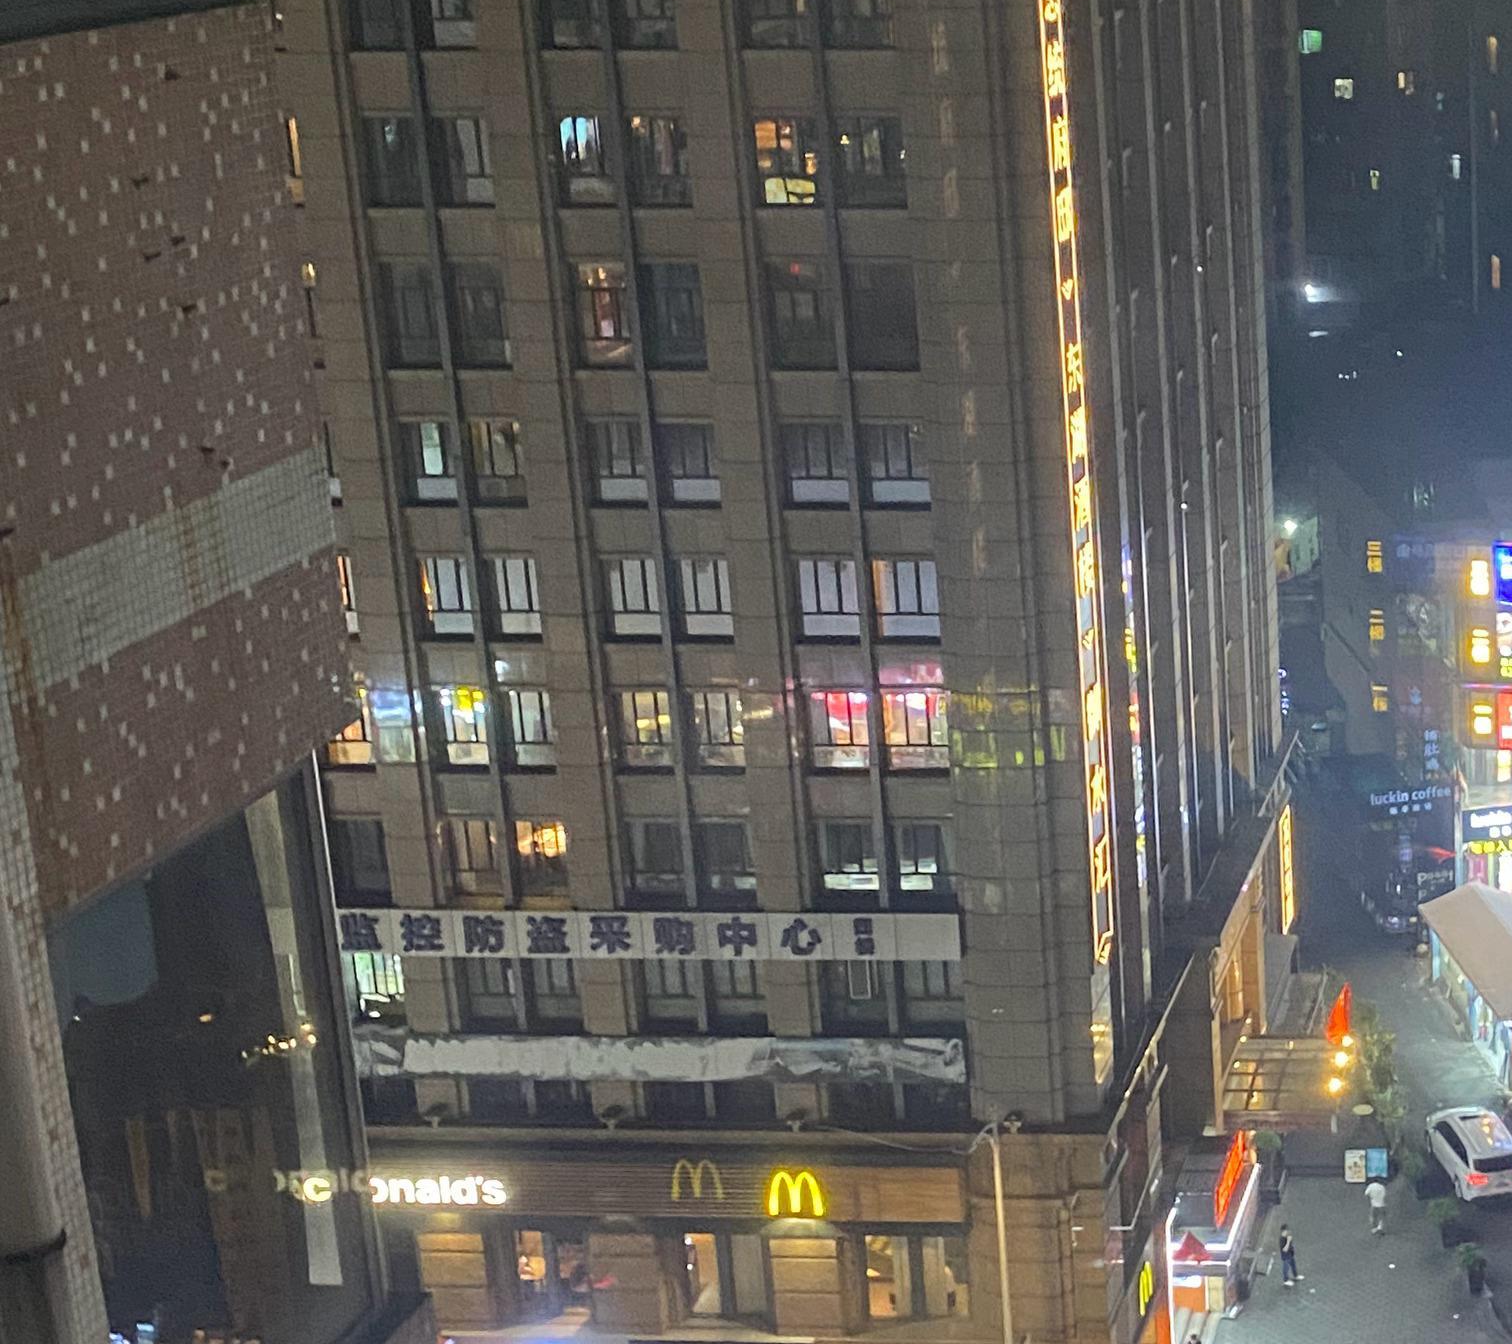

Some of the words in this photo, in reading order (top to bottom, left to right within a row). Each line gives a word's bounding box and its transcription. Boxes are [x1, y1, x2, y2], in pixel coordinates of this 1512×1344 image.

[341, 913, 822, 957] 监控防盗采购中心
